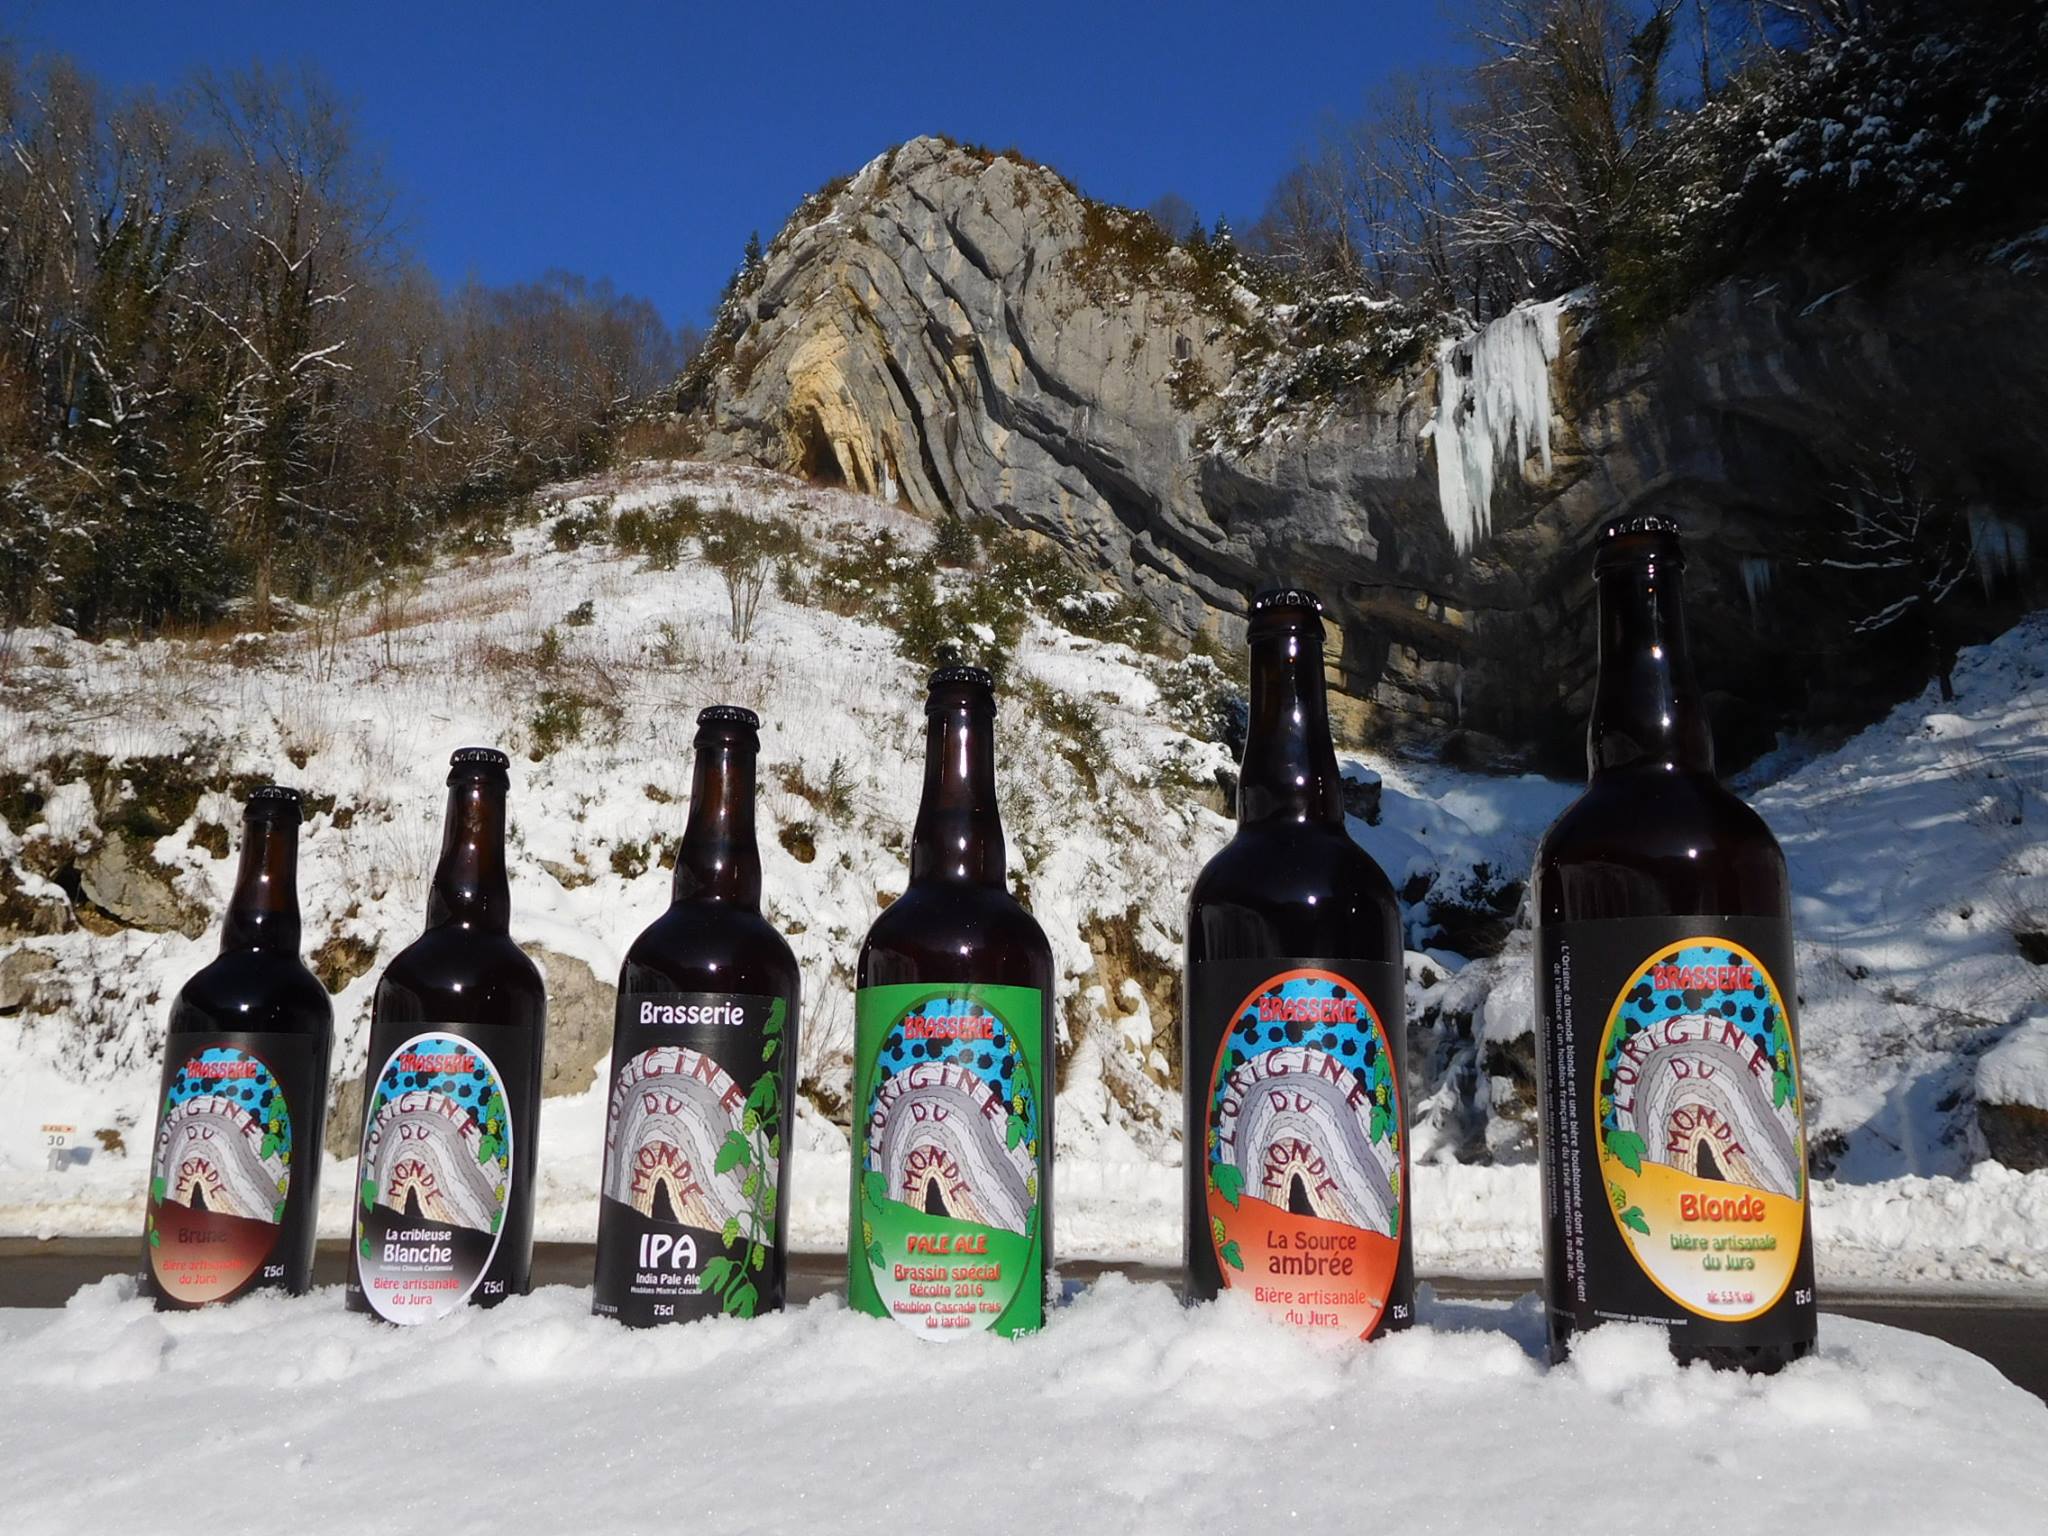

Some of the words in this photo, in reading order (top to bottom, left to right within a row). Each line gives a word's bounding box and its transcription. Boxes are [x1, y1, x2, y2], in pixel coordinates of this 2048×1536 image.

[1553, 963, 1562, 975] de
[1561, 946, 1572, 991] L'Origine
[1653, 964, 1756, 991] BRASSERIE
[1554, 977, 1564, 1020] l'alliance
[1563, 994, 1572, 1007] du
[640, 1001, 744, 1026] Brasserie
[1258, 997, 1359, 1023] BRASSERIE
[905, 1016, 995, 1040] BRASSERIE
[1556, 1023, 1566, 1046] d'un
[1564, 1009, 1574, 1042] monde
[187, 1061, 258, 1079] BRASSERIE
[400, 1054, 475, 1073] BRASSERIE
[1557, 1048, 1567, 1087] houblon
[1566, 1045, 1575, 1078] blonde
[1668, 1057, 1715, 1080] DU
[1568, 1080, 1577, 1096] est
[643, 1092, 682, 1114] DU
[911, 1102, 949, 1121] DU
[1269, 1090, 1314, 1114] DU
[1559, 1090, 1570, 1130] français
[1569, 1100, 1577, 1118] une
[48, 1135, 65, 1146] 30
[186, 1126, 214, 1141] DU
[400, 1124, 430, 1141] DU
[1561, 1133, 1569, 1143] et
[1570, 1121, 1580, 1146] bière
[1666, 1104, 1745, 1166] MONDE
[1562, 1146, 1571, 1159] du
[176, 1158, 227, 1198] MONDE
[631, 1141, 704, 1206] MONDE
[903, 1146, 971, 1201] MONDE
[1263, 1137, 1339, 1201] MONDE
[1562, 1162, 1572, 1187] style
[1571, 1149, 1583, 1208] houblonnée
[389, 1160, 443, 1205] MONDE
[1564, 1189, 1574, 1236] american
[1680, 1194, 1765, 1221] Blonde
[1574, 1210, 1584, 1233] dont
[178, 1228, 228, 1243] Brune
[386, 1228, 398, 1241] La
[400, 1229, 452, 1241] cribleuse
[1267, 1230, 1288, 1249] La
[1295, 1231, 1357, 1250] Source
[1575, 1236, 1584, 1246] le
[1670, 1234, 1708, 1250] bière
[1712, 1235, 1776, 1251] artisanale
[383, 1243, 452, 1263] Blanche
[639, 1234, 697, 1269] IPA
[907, 1236, 949, 1254] PALE
[954, 1235, 989, 1254] ALE
[1566, 1239, 1575, 1260] pale
[1269, 1251, 1353, 1276] ambrée
[1575, 1249, 1586, 1273] goût
[1702, 1254, 1721, 1270] du
[1726, 1254, 1755, 1270] Jura
[179, 1274, 192, 1285] du
[195, 1274, 217, 1285] Jura
[263, 1264, 284, 1278] 75cl
[636, 1272, 658, 1284] India
[660, 1273, 681, 1285] Pale
[684, 1273, 701, 1285] Ale
[895, 1263, 947, 1281] Brassin
[952, 1263, 1001, 1281] spécial
[1567, 1263, 1576, 1282] ale.
[374, 1277, 399, 1289] Bière
[402, 1278, 459, 1290] artisanale
[484, 1281, 505, 1294] 75cl
[909, 1282, 951, 1297] Récolte
[955, 1283, 984, 1297] 2016
[1577, 1275, 1587, 1302] vient
[392, 1293, 405, 1305] du
[408, 1294, 432, 1305] Jura
[1255, 1286, 1293, 1304] Bière
[1302, 1288, 1366, 1305] artisanale
[653, 1304, 674, 1316] 75cl
[934, 1301, 976, 1314] Cascade
[1393, 1303, 1409, 1320] 75cl
[926, 1316, 938, 1328] du
[941, 1316, 970, 1328] jardin
[1285, 1309, 1303, 1325] du
[1308, 1310, 1339, 1326] Jura
